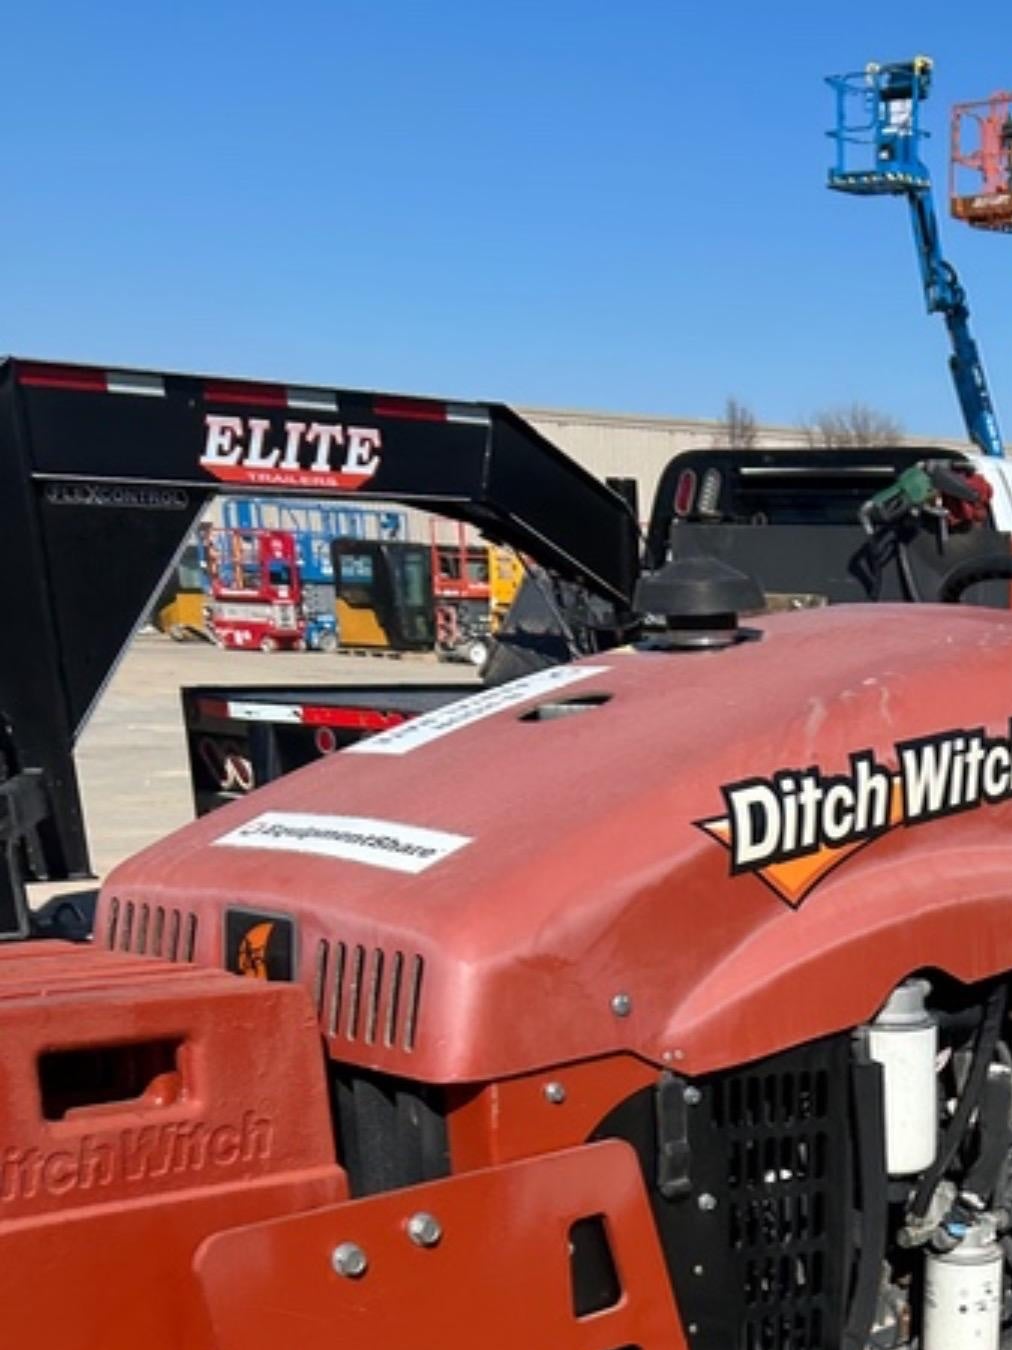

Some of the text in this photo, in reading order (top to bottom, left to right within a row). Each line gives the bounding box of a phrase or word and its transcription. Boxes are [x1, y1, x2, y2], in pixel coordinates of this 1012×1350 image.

[199, 414, 382, 475] ELITE
[248, 472, 338, 487] TRAILERS
[731, 760, 890, 865] Ditch
[0, 1110, 275, 1201] itch Witch
